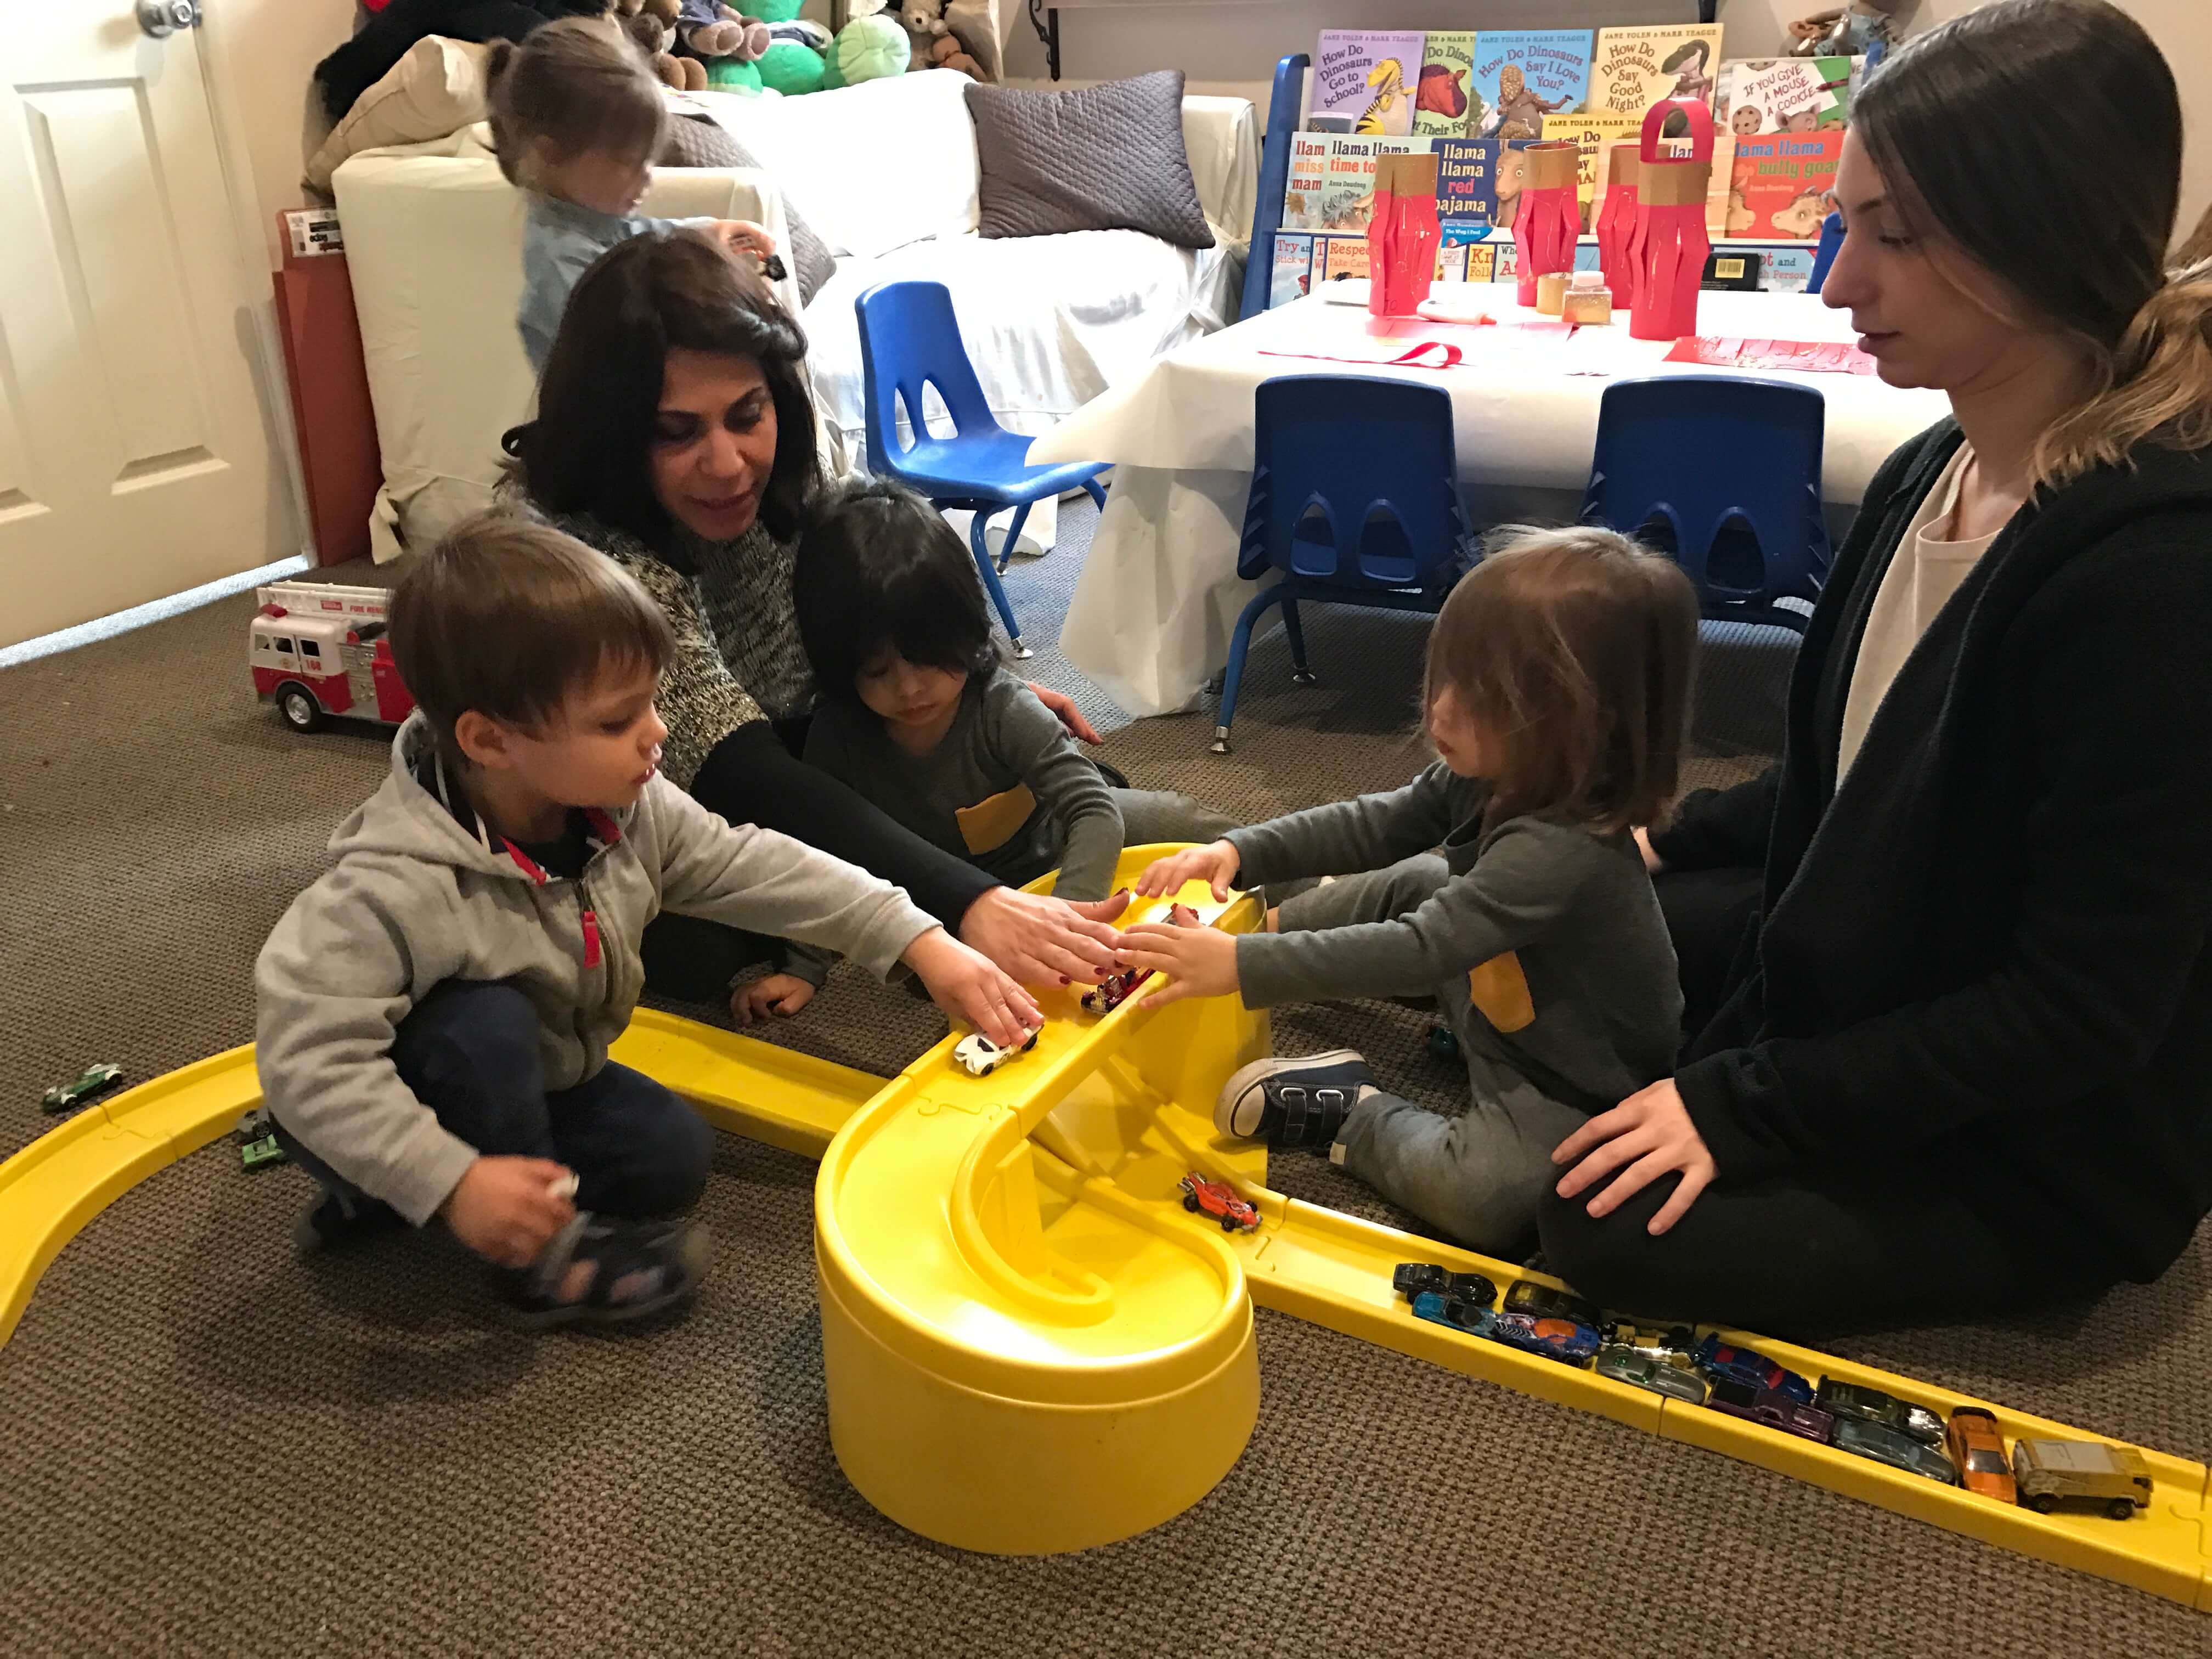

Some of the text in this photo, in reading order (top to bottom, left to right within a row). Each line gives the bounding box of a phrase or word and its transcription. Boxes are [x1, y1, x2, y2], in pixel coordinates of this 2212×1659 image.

[1322, 44, 1363, 66] How Do
[1427, 46, 1443, 58] Do
[1609, 42, 1655, 59] How Do
[1479, 45, 1584, 78] How Do Dinosaurs
[1601, 56, 1658, 77] Dinosaurs
[1319, 58, 1373, 82] Dinosaurs
[1526, 61, 1581, 83] Say I Love
[1618, 69, 1639, 83] Say
[1329, 73, 1359, 90] Go to
[1537, 76, 1564, 91] You?
[1610, 81, 1643, 96] Good
[1743, 64, 1804, 97] IF YOU GIVE
[1324, 83, 1364, 108] School?
[1764, 76, 1809, 103] A MOUSE
[1606, 94, 1646, 113] Night?
[1768, 86, 1817, 117] A COOKIE
[1422, 122, 1449, 135] Their
[1584, 131, 1601, 143] Do
[1296, 140, 1325, 156] llam
[1332, 140, 1369, 156] llama
[1443, 144, 1486, 160] llama
[1778, 140, 1824, 155] llama
[1294, 158, 1324, 173] miss
[1330, 157, 1376, 173] time to
[1442, 161, 1484, 177] llama
[1758, 160, 1798, 179] bully
[1292, 179, 1322, 191] mam
[1448, 178, 1475, 194] red
[1277, 239, 1299, 253] Try
[1316, 242, 1325, 256] T
[1276, 255, 1296, 264] Stick
[1314, 259, 1323, 269] W
[1329, 258, 1347, 267] Take
[1778, 258, 1796, 266] and
[1773, 270, 1806, 279] Person
